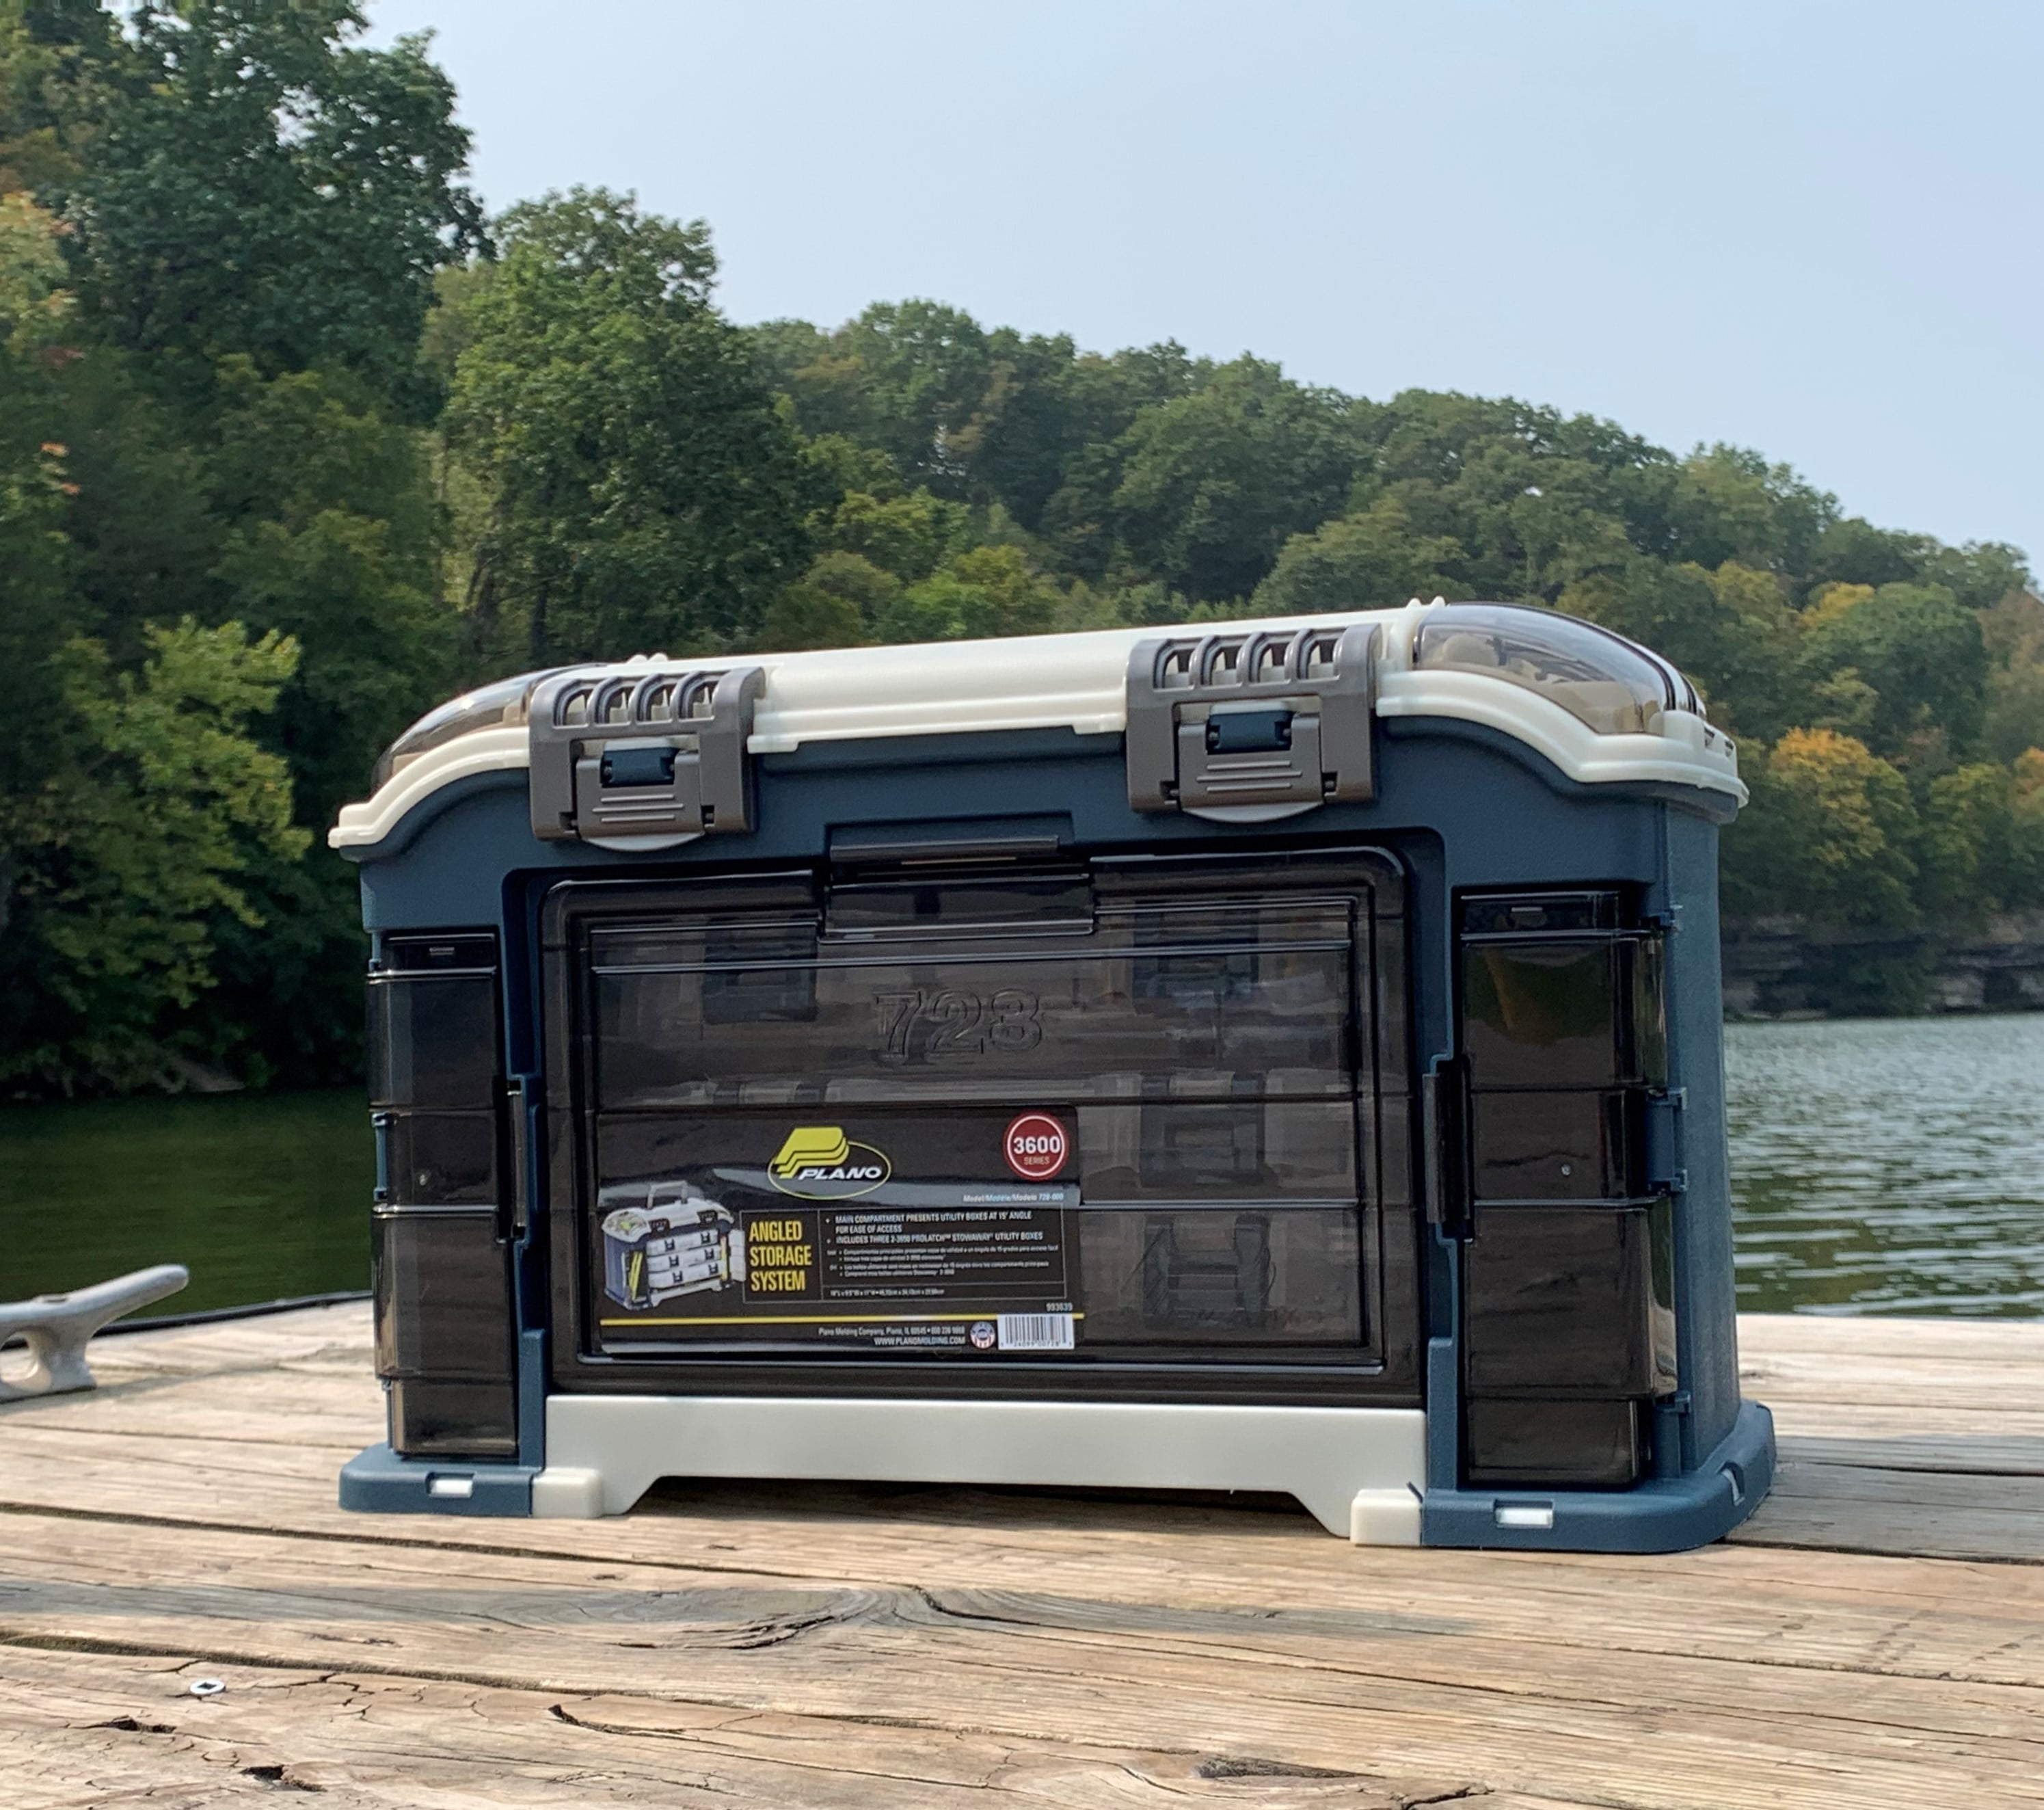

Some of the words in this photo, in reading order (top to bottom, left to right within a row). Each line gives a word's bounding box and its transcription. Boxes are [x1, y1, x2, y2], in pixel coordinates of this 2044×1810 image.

[872, 989, 1043, 1059] 728
[1013, 1136, 1061, 1154] 3600
[1023, 1156, 1050, 1165] SERIES
[798, 1167, 882, 1180] PLANO
[835, 1216, 854, 1224] MAIN
[855, 1214, 904, 1223] COMPARTMENT
[906, 1213, 939, 1222] PRESENTS
[940, 1212, 965, 1221] UTILITY
[965, 1211, 989, 1221] BOXES
[1009, 1211, 1032, 1219] ANGLE
[749, 1221, 802, 1242] ANGLED
[867, 1225, 876, 1233] OF
[876, 1224, 902, 1233] ACCESS
[835, 1236, 869, 1244] INCLUDES
[870, 1235, 890, 1243] THREE
[995, 1232, 1020, 1241] UTILITY
[1021, 1231, 1043, 1240] BOXES
[750, 1246, 812, 1266] STORAGE
[751, 1270, 806, 1291] SYSTEM
